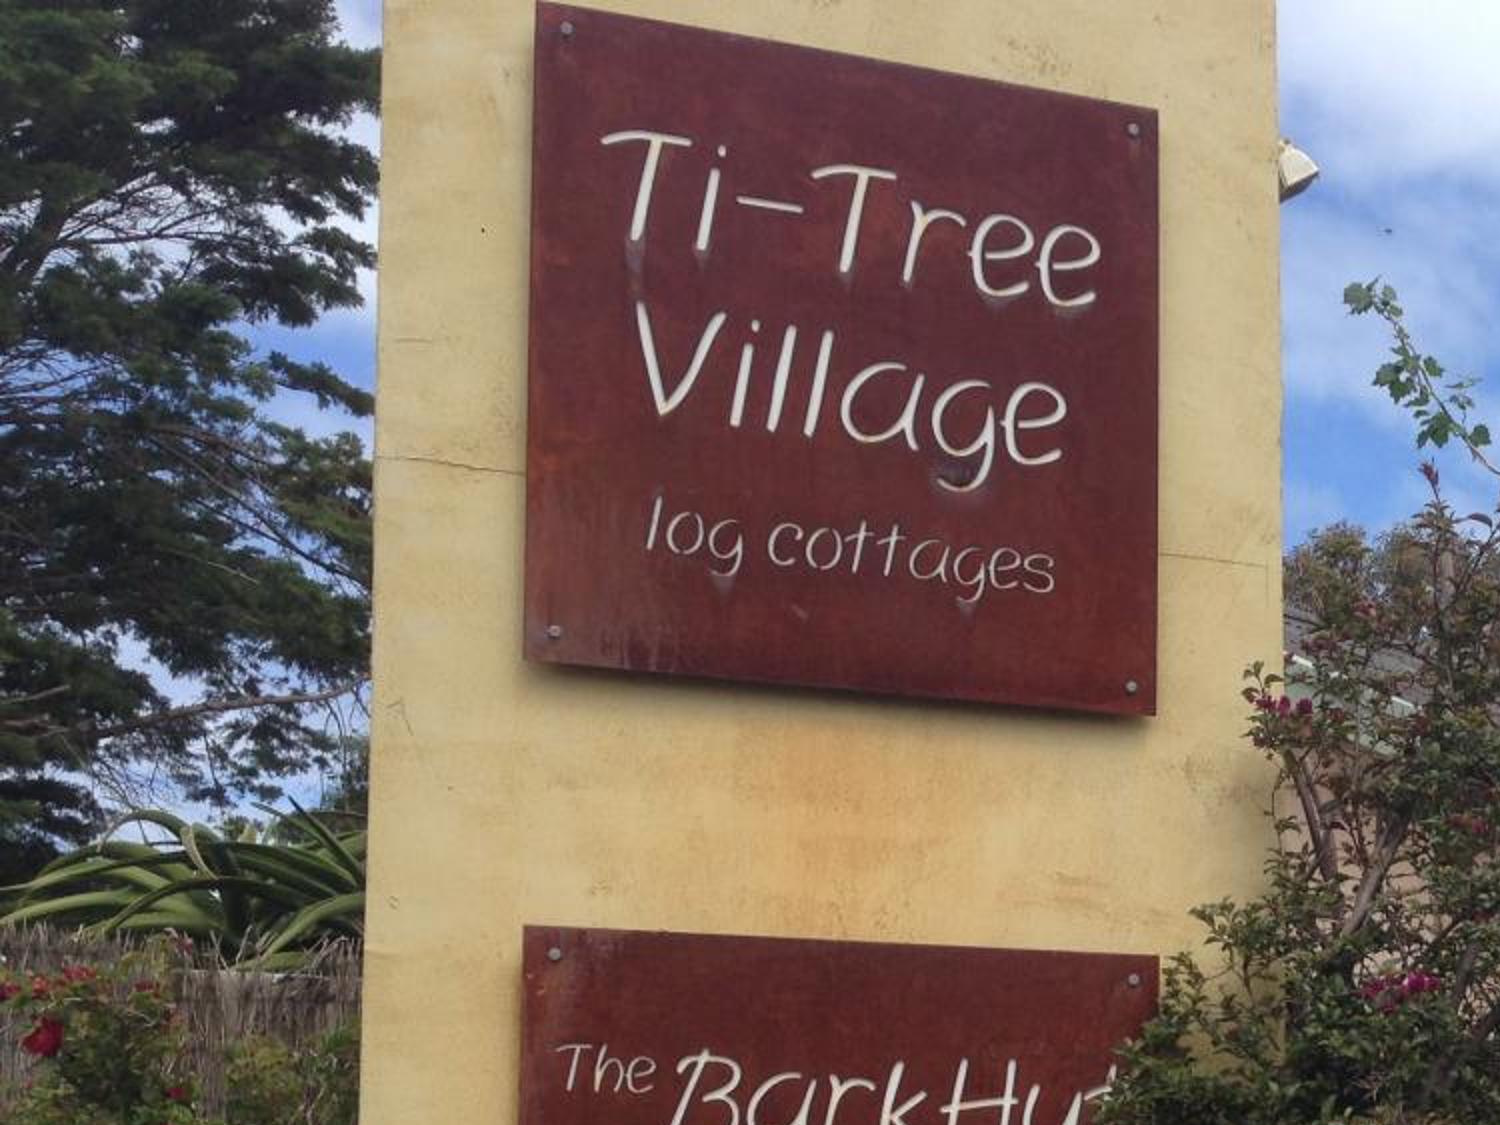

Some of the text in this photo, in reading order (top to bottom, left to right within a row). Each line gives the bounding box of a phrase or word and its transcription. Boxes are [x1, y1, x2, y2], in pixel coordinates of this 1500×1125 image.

[600, 130, 1101, 308] Ti-Tree
[635, 301, 1067, 493] Village
[645, 496, 1056, 604] log cottages
[555, 1043, 658, 1095] The
